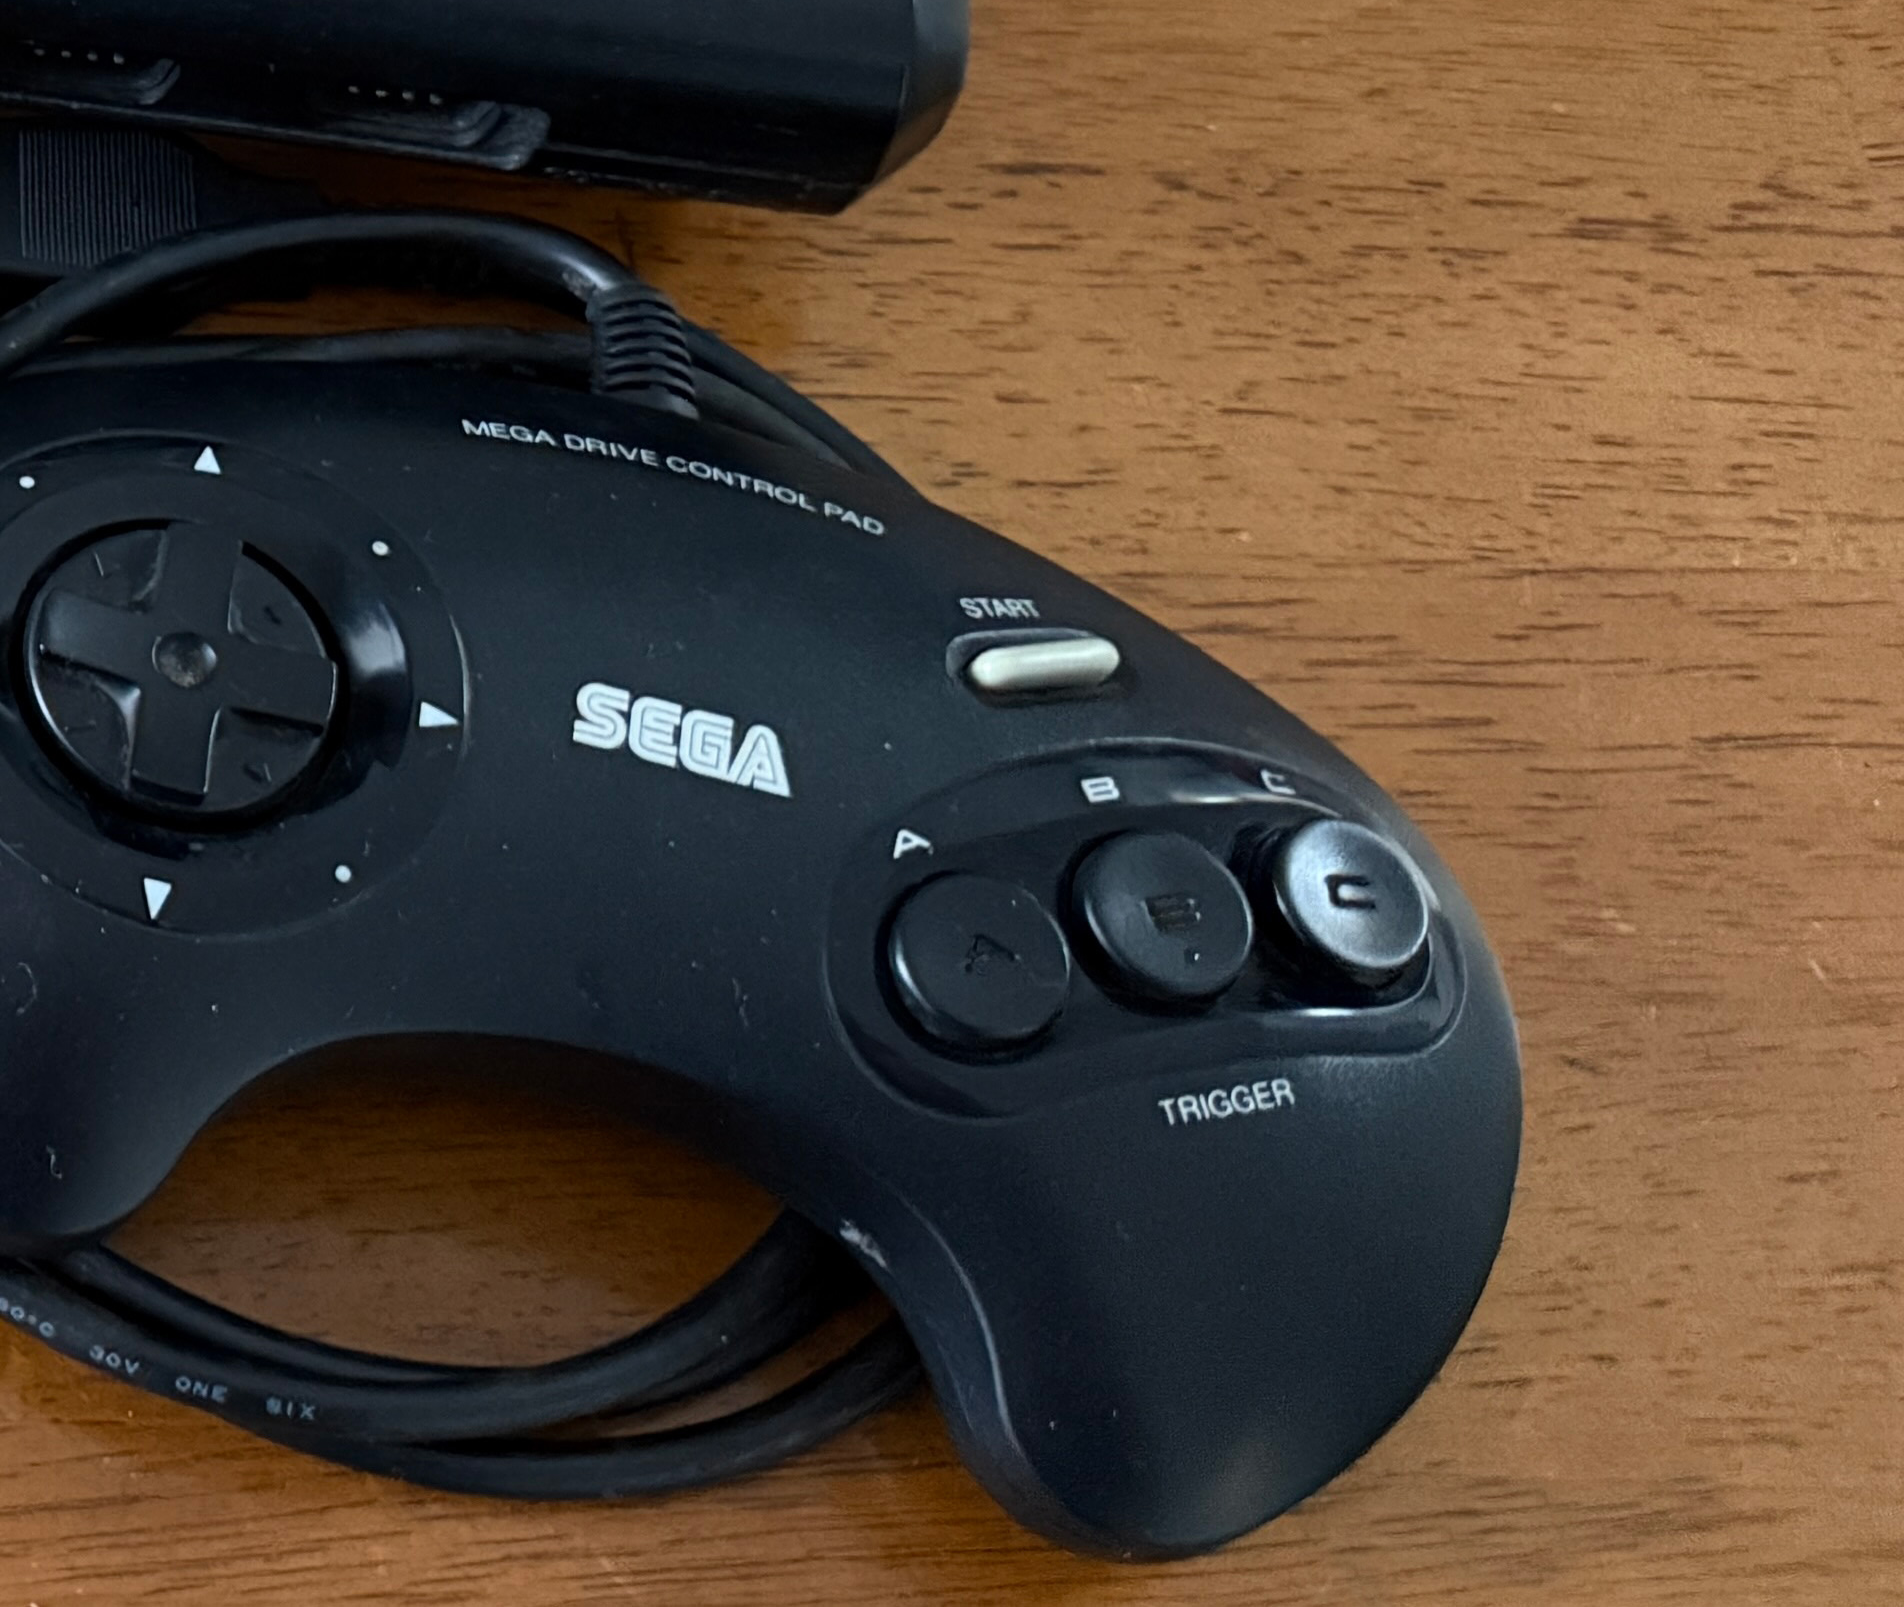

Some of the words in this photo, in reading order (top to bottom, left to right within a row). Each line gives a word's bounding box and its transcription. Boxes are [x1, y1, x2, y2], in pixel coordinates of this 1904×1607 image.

[462, 418, 556, 447] MEGA
[565, 431, 660, 467] DRIVE
[666, 454, 817, 513] CONTROL
[823, 501, 886, 537] PAD
[960, 598, 1040, 619] START
[572, 682, 791, 797] SEGA
[1081, 776, 1120, 802] B
[893, 828, 932, 859] A
[1325, 874, 1378, 910] C
[1158, 1078, 1294, 1127] TRIGGER
[174, 1375, 229, 1404] ONE
